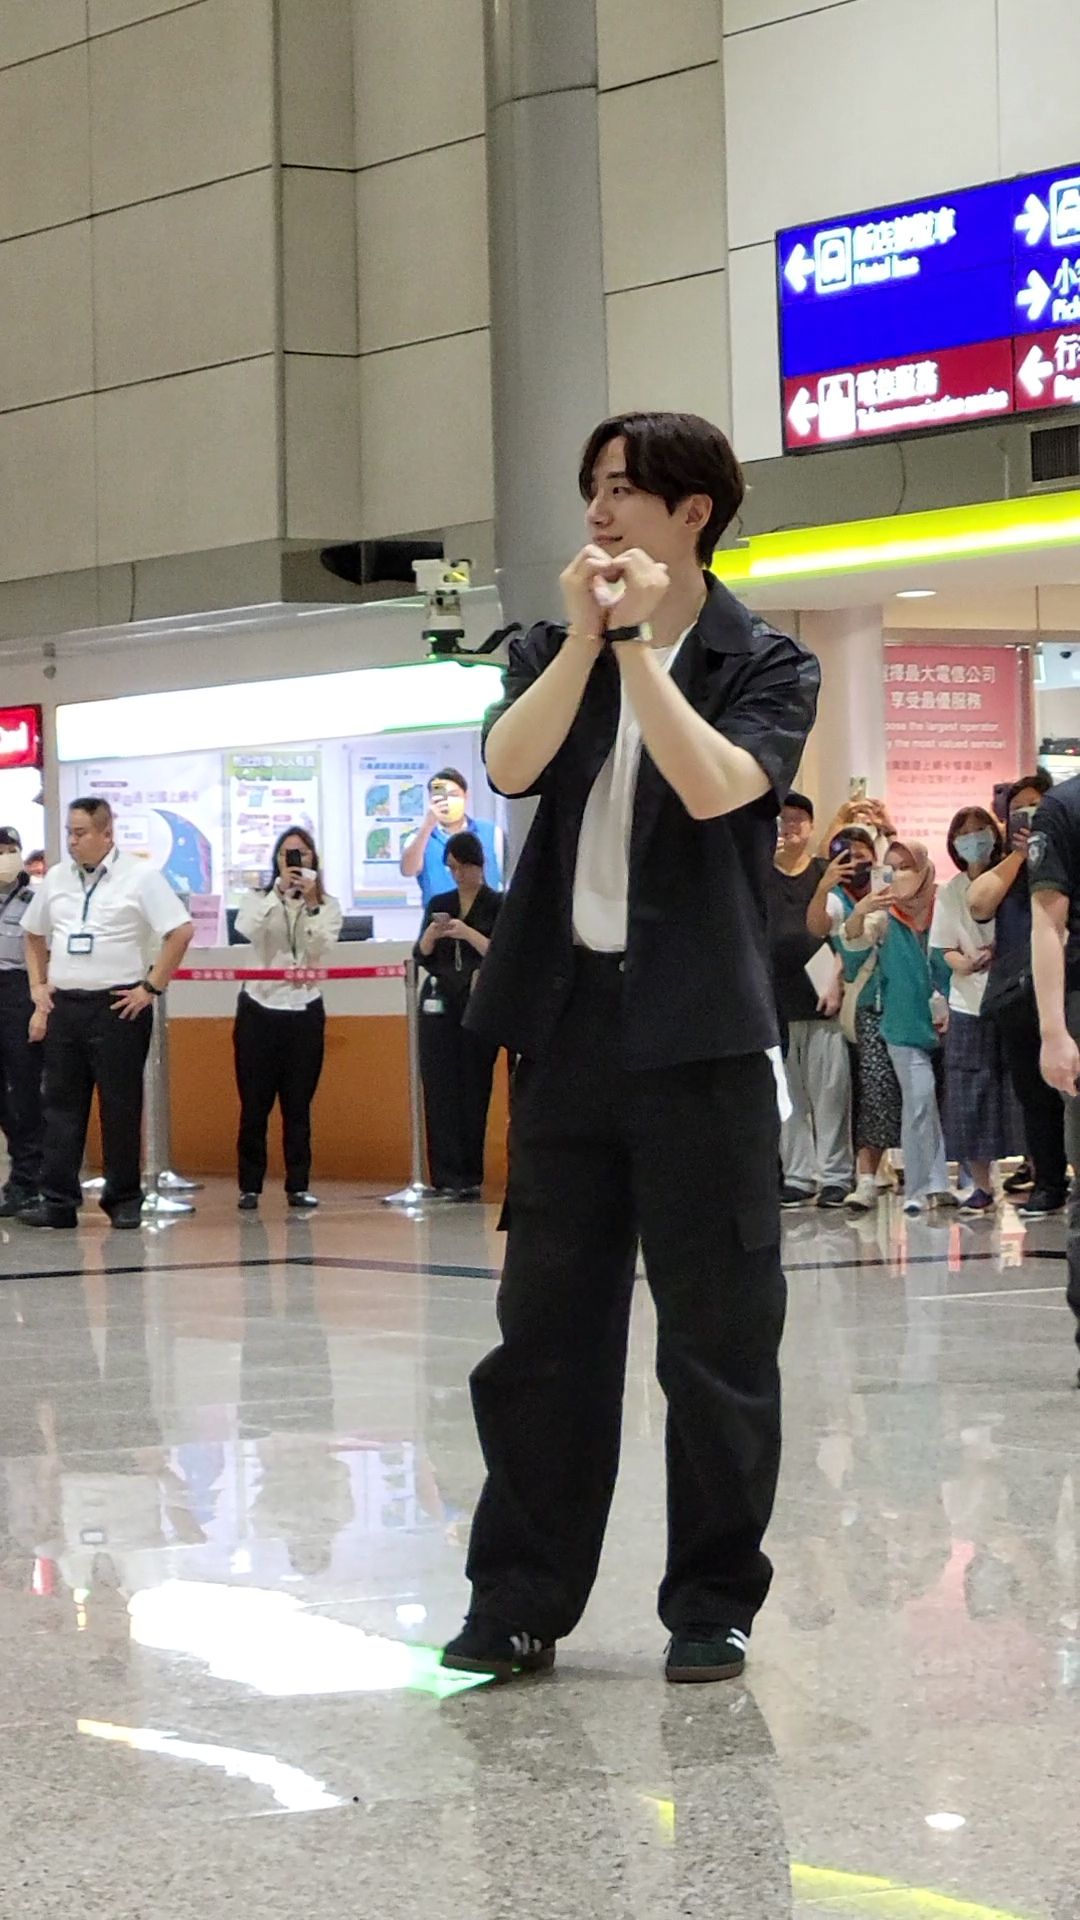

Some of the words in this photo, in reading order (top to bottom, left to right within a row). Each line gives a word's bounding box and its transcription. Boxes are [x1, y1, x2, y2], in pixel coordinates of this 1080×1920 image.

[853, 256, 890, 284] Hotel
[892, 255, 920, 277] bus
[909, 721, 924, 731] the
[926, 721, 958, 734] largest
